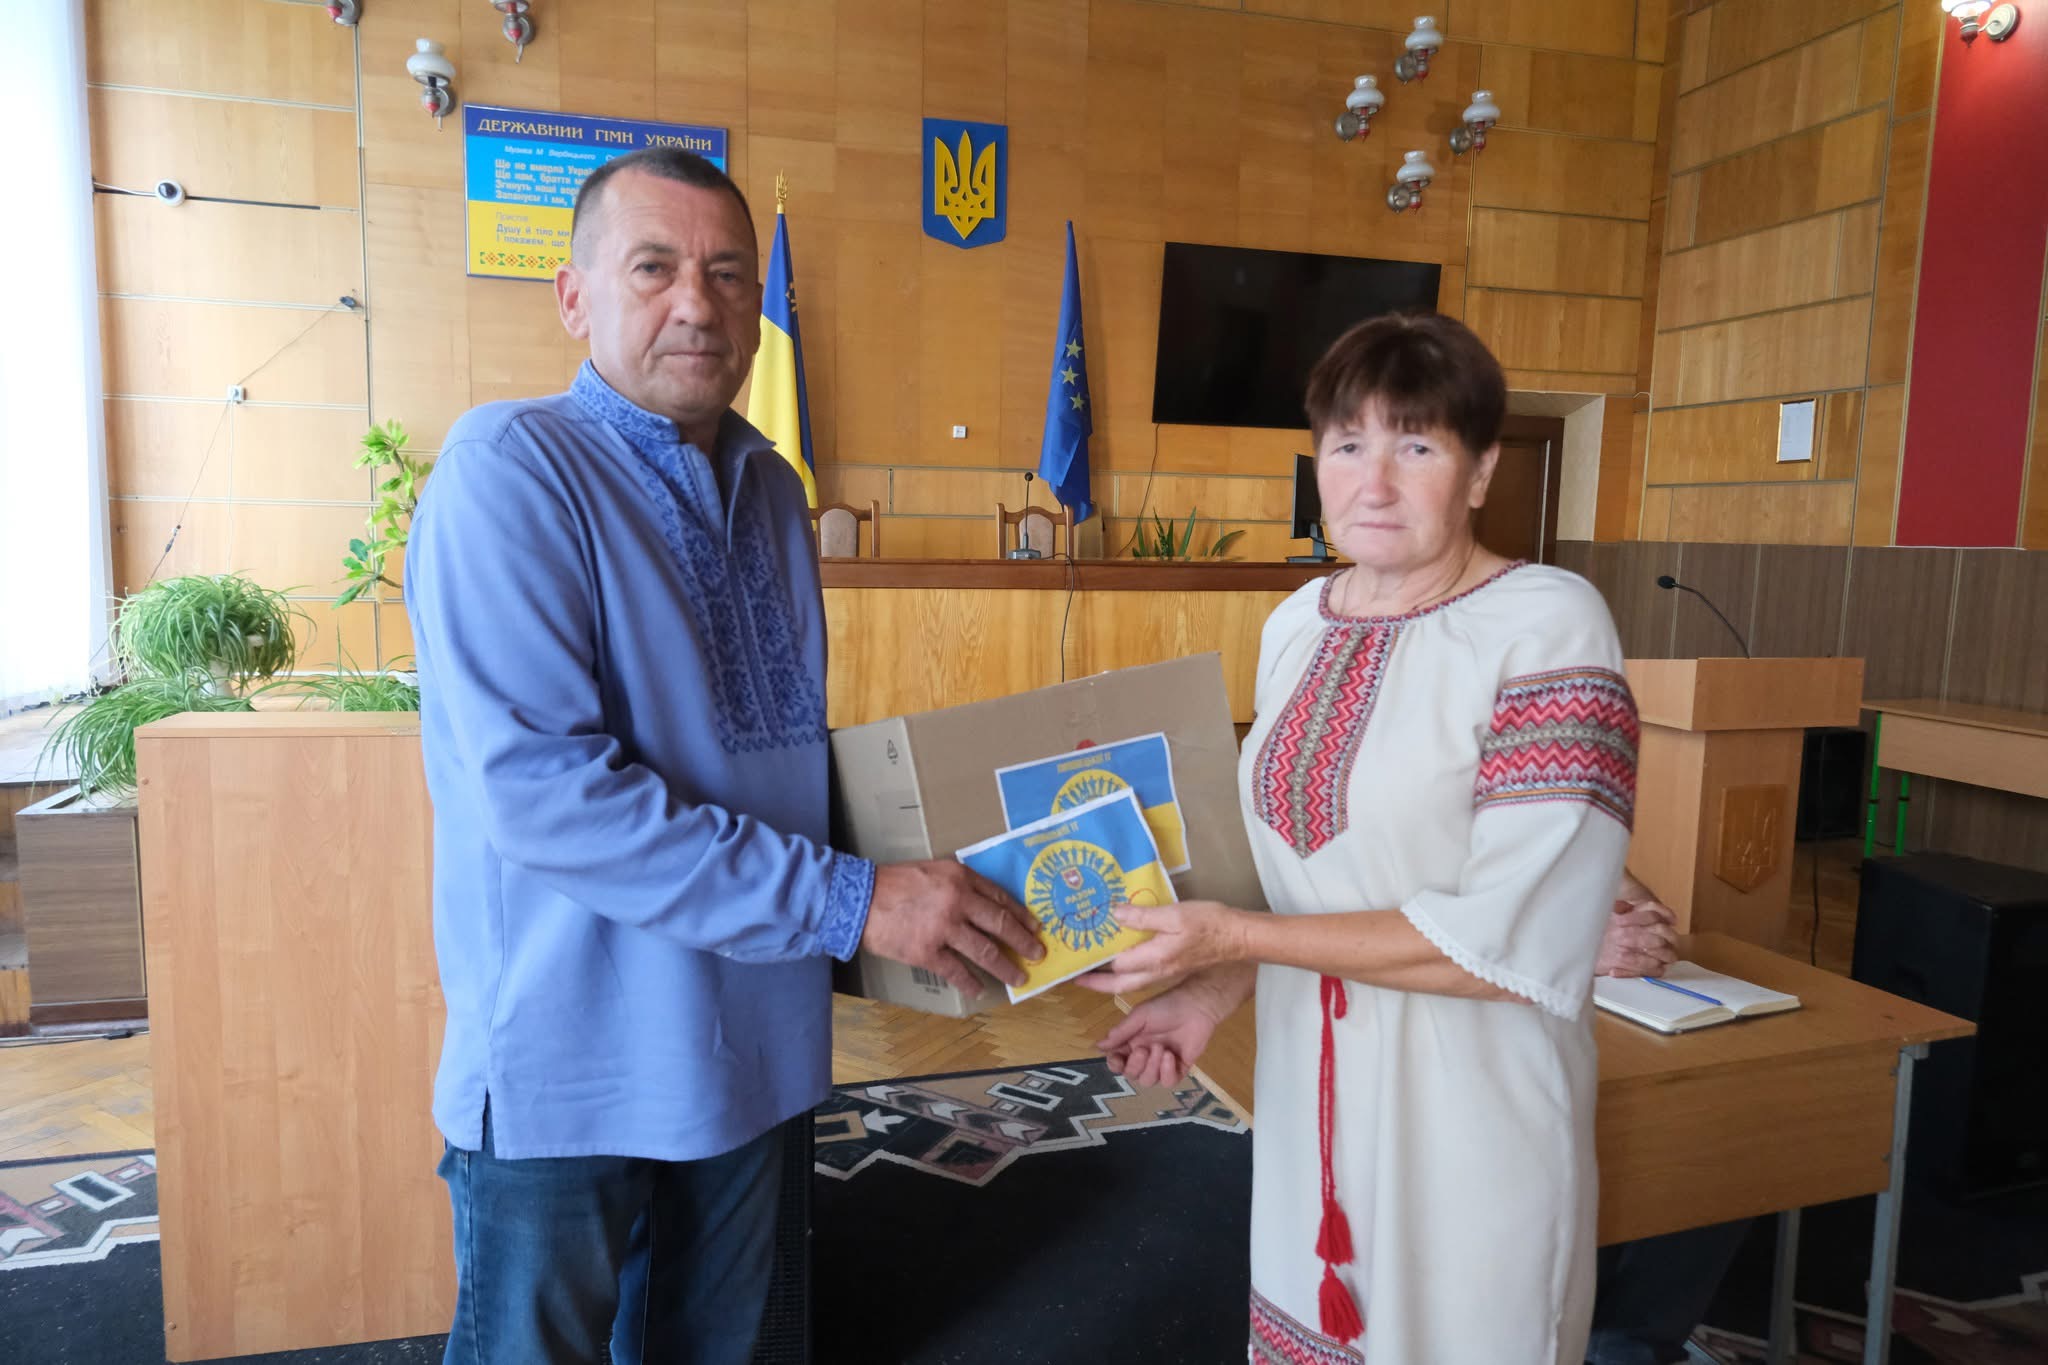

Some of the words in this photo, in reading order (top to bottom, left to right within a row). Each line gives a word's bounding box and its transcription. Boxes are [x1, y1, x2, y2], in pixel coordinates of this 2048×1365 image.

[595, 129, 633, 144] ГІМН
[645, 133, 712, 151] УКРАЇНИ
[496, 223, 521, 234] Душу
[536, 228, 553, 236] тіло
